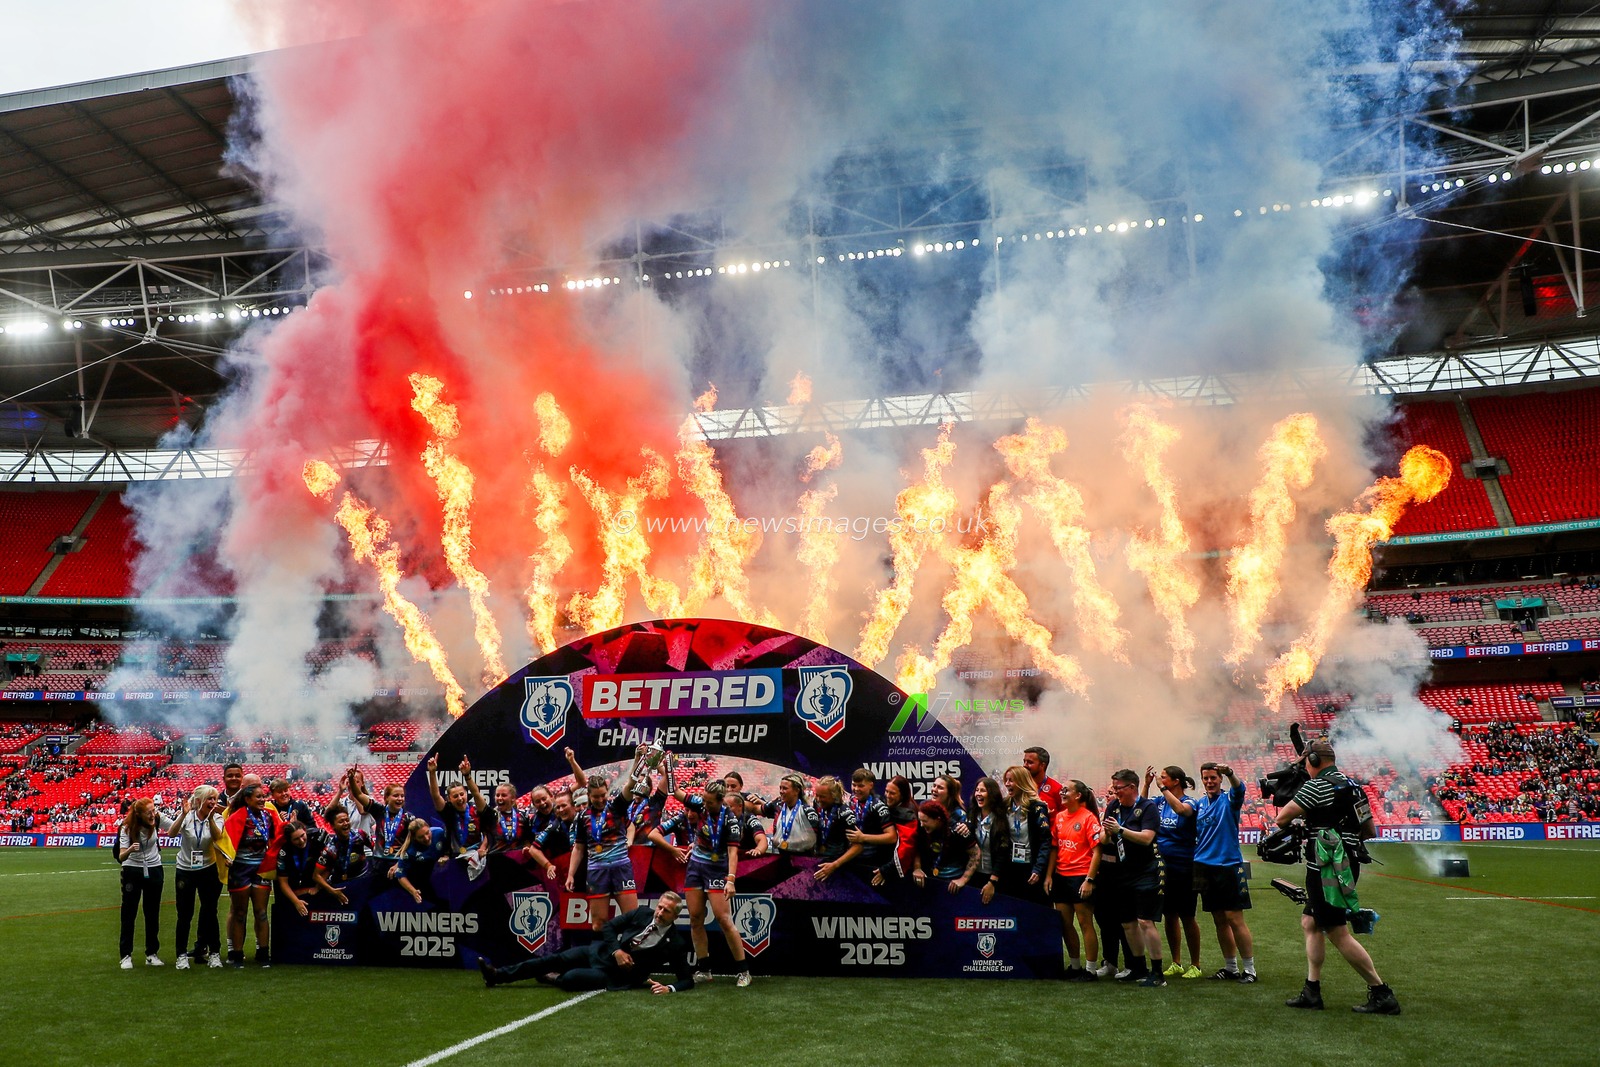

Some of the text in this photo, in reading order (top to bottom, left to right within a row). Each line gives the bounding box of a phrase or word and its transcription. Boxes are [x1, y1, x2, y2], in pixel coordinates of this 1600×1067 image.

[1509, 526, 1543, 534] WEMBLEY
[1543, 521, 1588, 531] CONNECTED
[1411, 535, 1442, 543] WEMBLEY
[1442, 531, 1485, 540] CONNECTED
[1468, 645, 1511, 656] BETFRED
[1525, 642, 1569, 653] BETFRED
[959, 670, 994, 680] BETFRED
[1006, 668, 1041, 678] BETFRED
[2, 691, 35, 700] BETFRED
[45, 692, 76, 700] BETFRED
[85, 692, 116, 701] BETFRED
[125, 692, 154, 700] BETFRED
[202, 691, 231, 699] BETFRED
[589, 675, 775, 712] BETFRED
[597, 724, 768, 747] CHALLENGE CUP
[863, 760, 961, 780] WINNERS
[1382, 827, 1442, 841] BETFRED
[1463, 826, 1525, 841] BETFRED
[1547, 825, 1600, 840] BETFRE
[46, 835, 85, 847] BETFRED
[622, 879, 636, 889] LCS
[708, 879, 725, 889] LCS
[310, 912, 356, 922] BETFRED
[376, 911, 479, 934] WINNERS
[811, 916, 933, 940] WINNERS
[957, 918, 1015, 930] BETFRED
[400, 935, 456, 957] 2025
[839, 942, 906, 966] 2025
